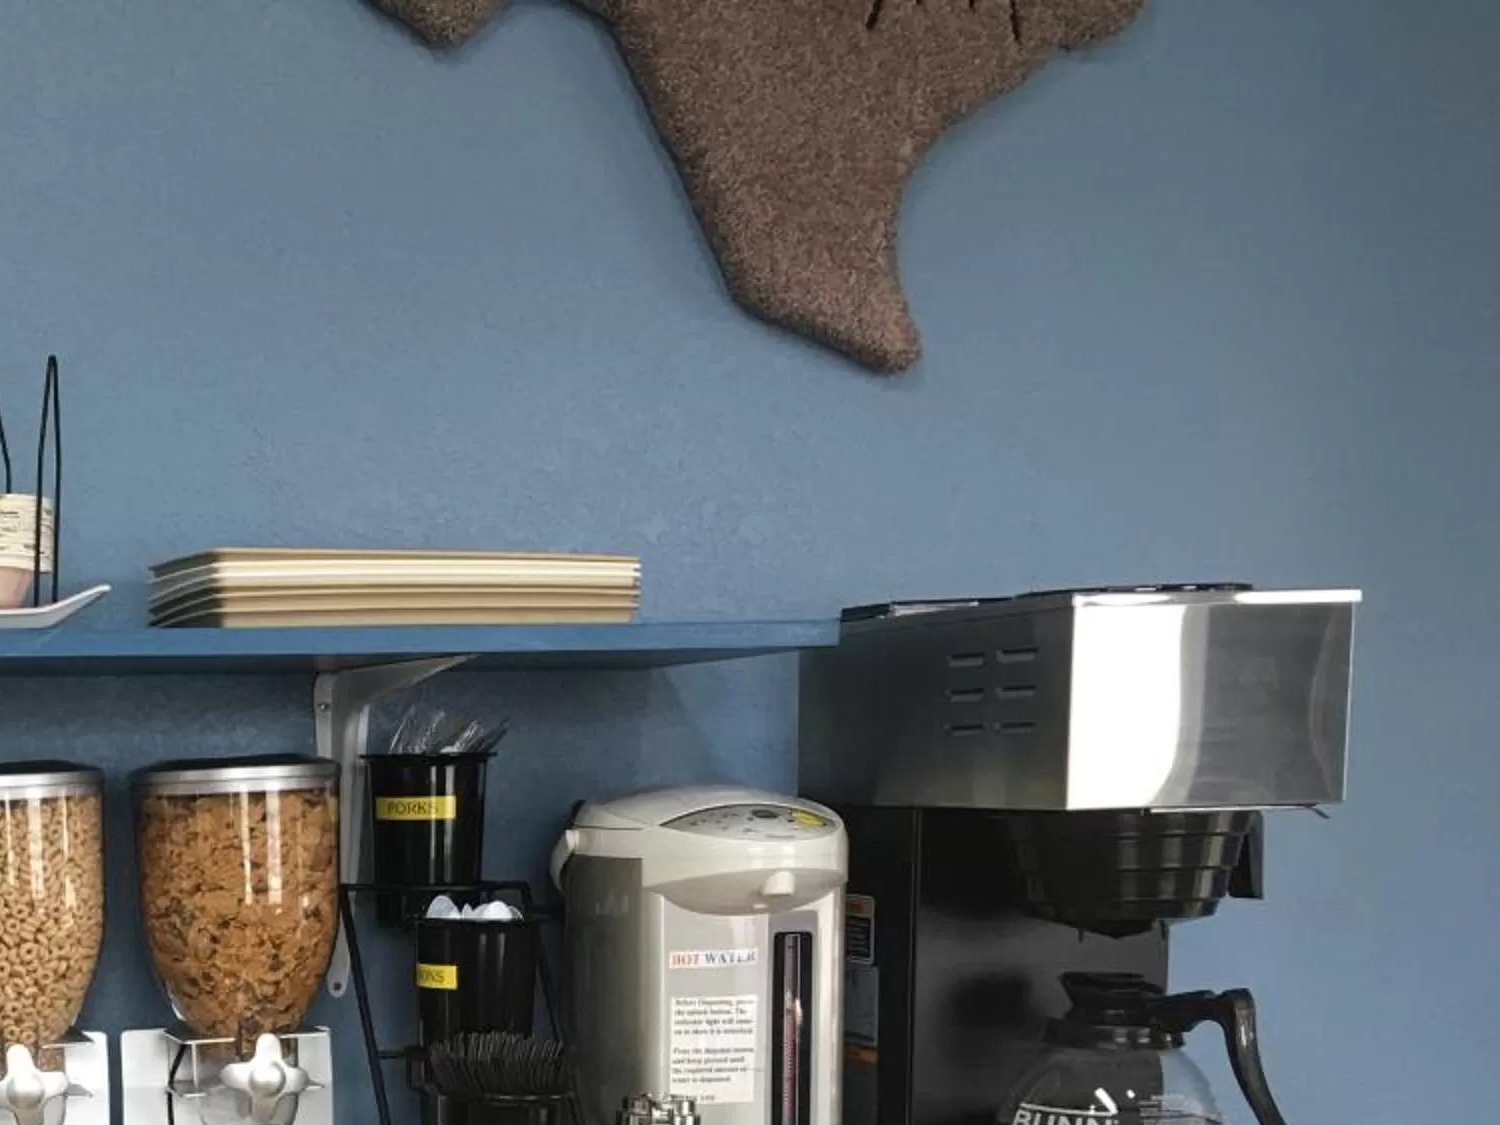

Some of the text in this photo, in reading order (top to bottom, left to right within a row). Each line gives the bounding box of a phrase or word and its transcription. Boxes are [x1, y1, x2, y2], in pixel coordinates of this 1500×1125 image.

[387, 800, 438, 815] FORKS
[672, 954, 699, 965] HOT
[419, 968, 445, 984] ONS
